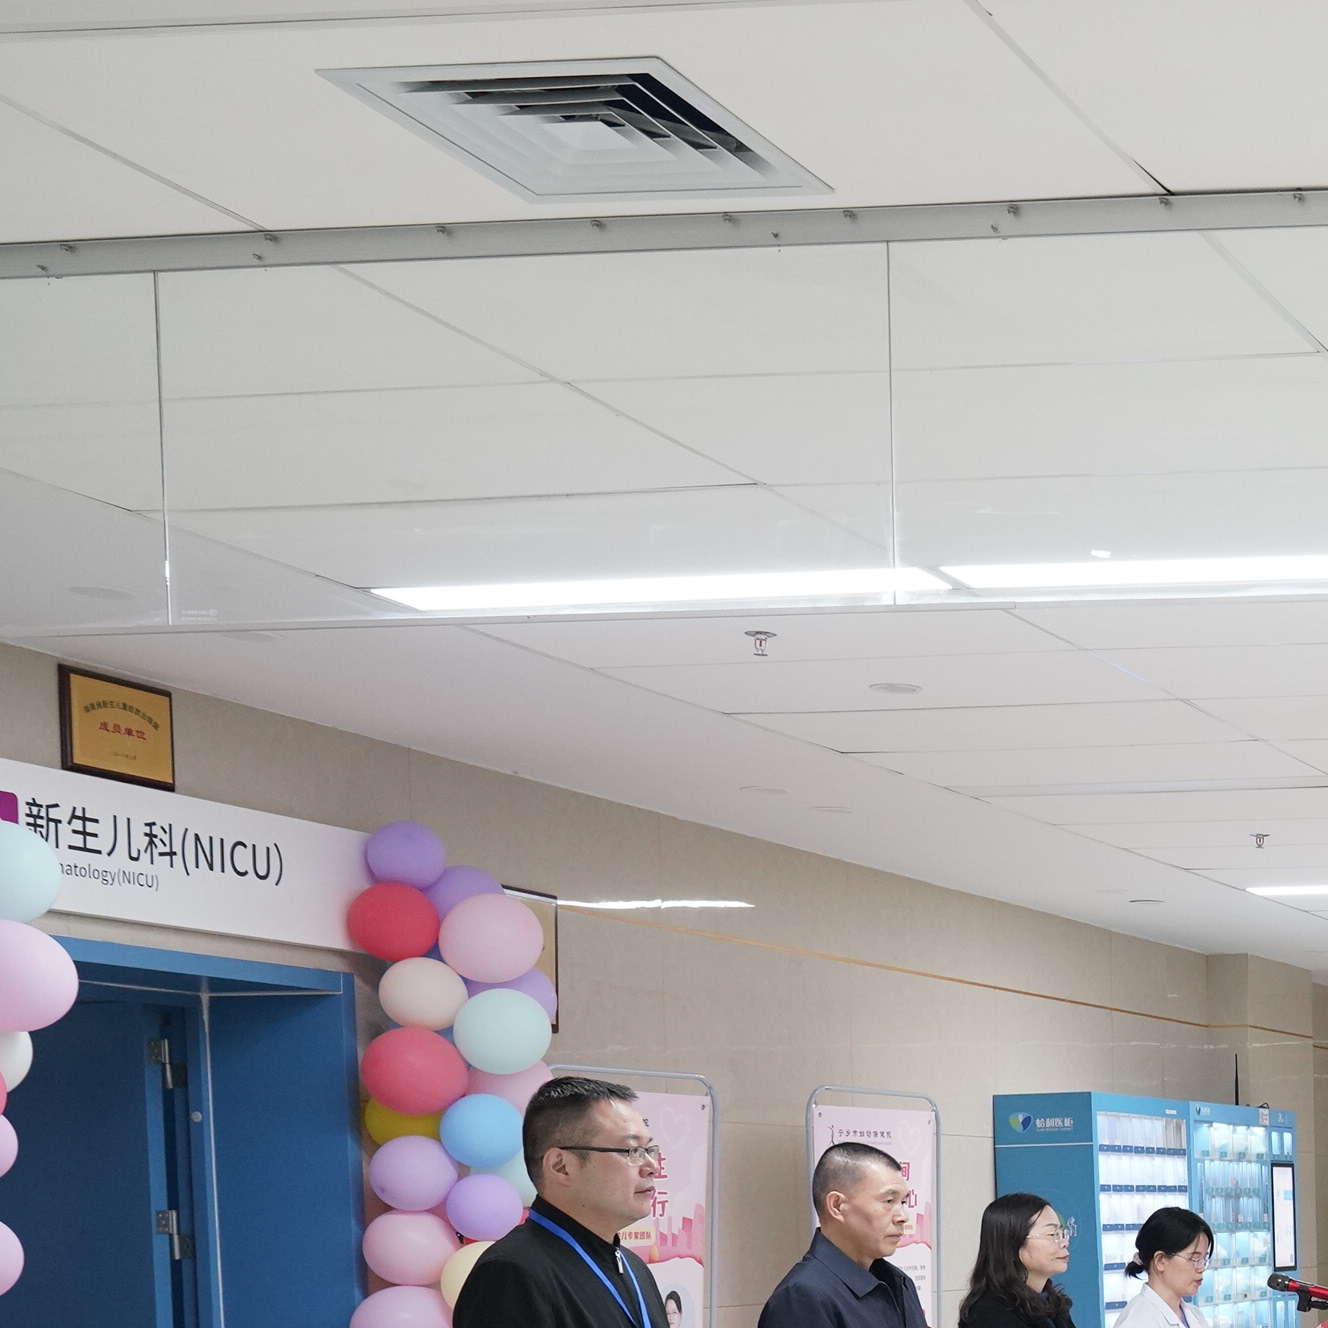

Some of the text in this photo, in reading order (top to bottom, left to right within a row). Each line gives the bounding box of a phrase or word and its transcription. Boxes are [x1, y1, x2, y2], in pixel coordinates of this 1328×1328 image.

[98, 721, 147, 741] 成员单位
[25, 797, 283, 886] 新生儿科(NICU)
[651, 1189, 669, 1218] 行
